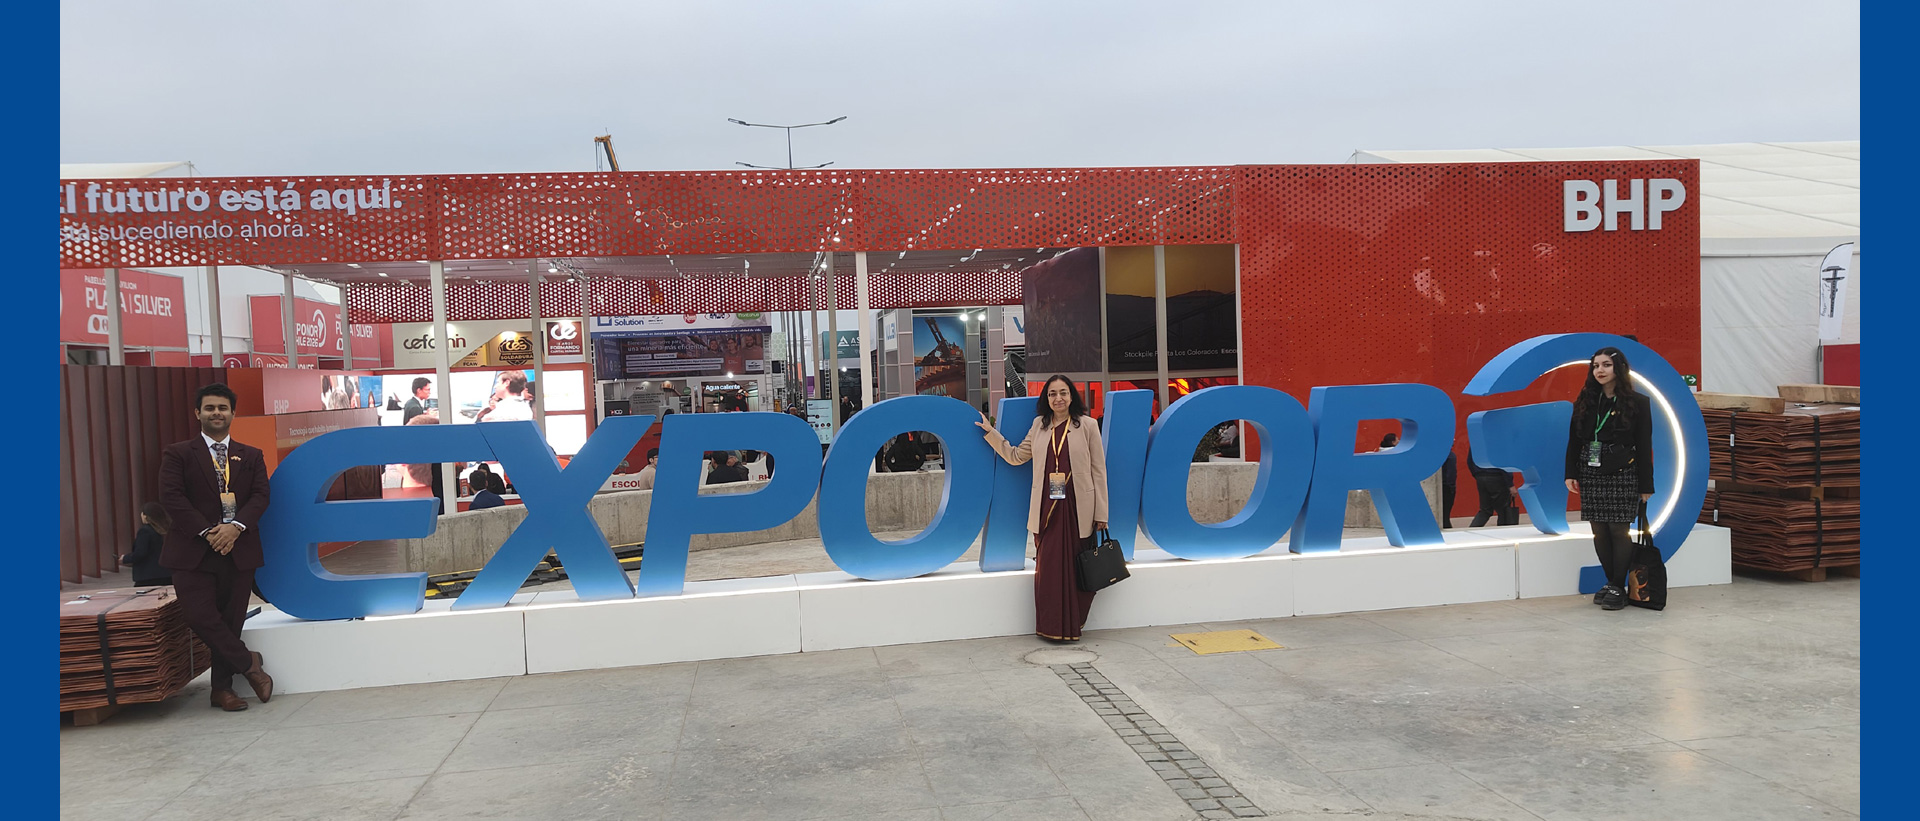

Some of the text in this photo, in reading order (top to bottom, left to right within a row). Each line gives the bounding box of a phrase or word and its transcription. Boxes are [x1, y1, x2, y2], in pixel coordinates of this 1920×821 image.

[85, 183, 210, 213] futuro
[219, 182, 302, 212] está
[310, 181, 403, 215] aquí.
[1563, 178, 1687, 233] BHP
[98, 219, 233, 241] sucediendo
[134, 294, 172, 317] SILVER
[614, 318, 644, 327] Solution
[296, 323, 318, 338] PONOR
[355, 324, 373, 339] SILVER
[296, 337, 306, 347] HILE
[705, 384, 720, 392] Agua
[274, 399, 290, 414] BHP
